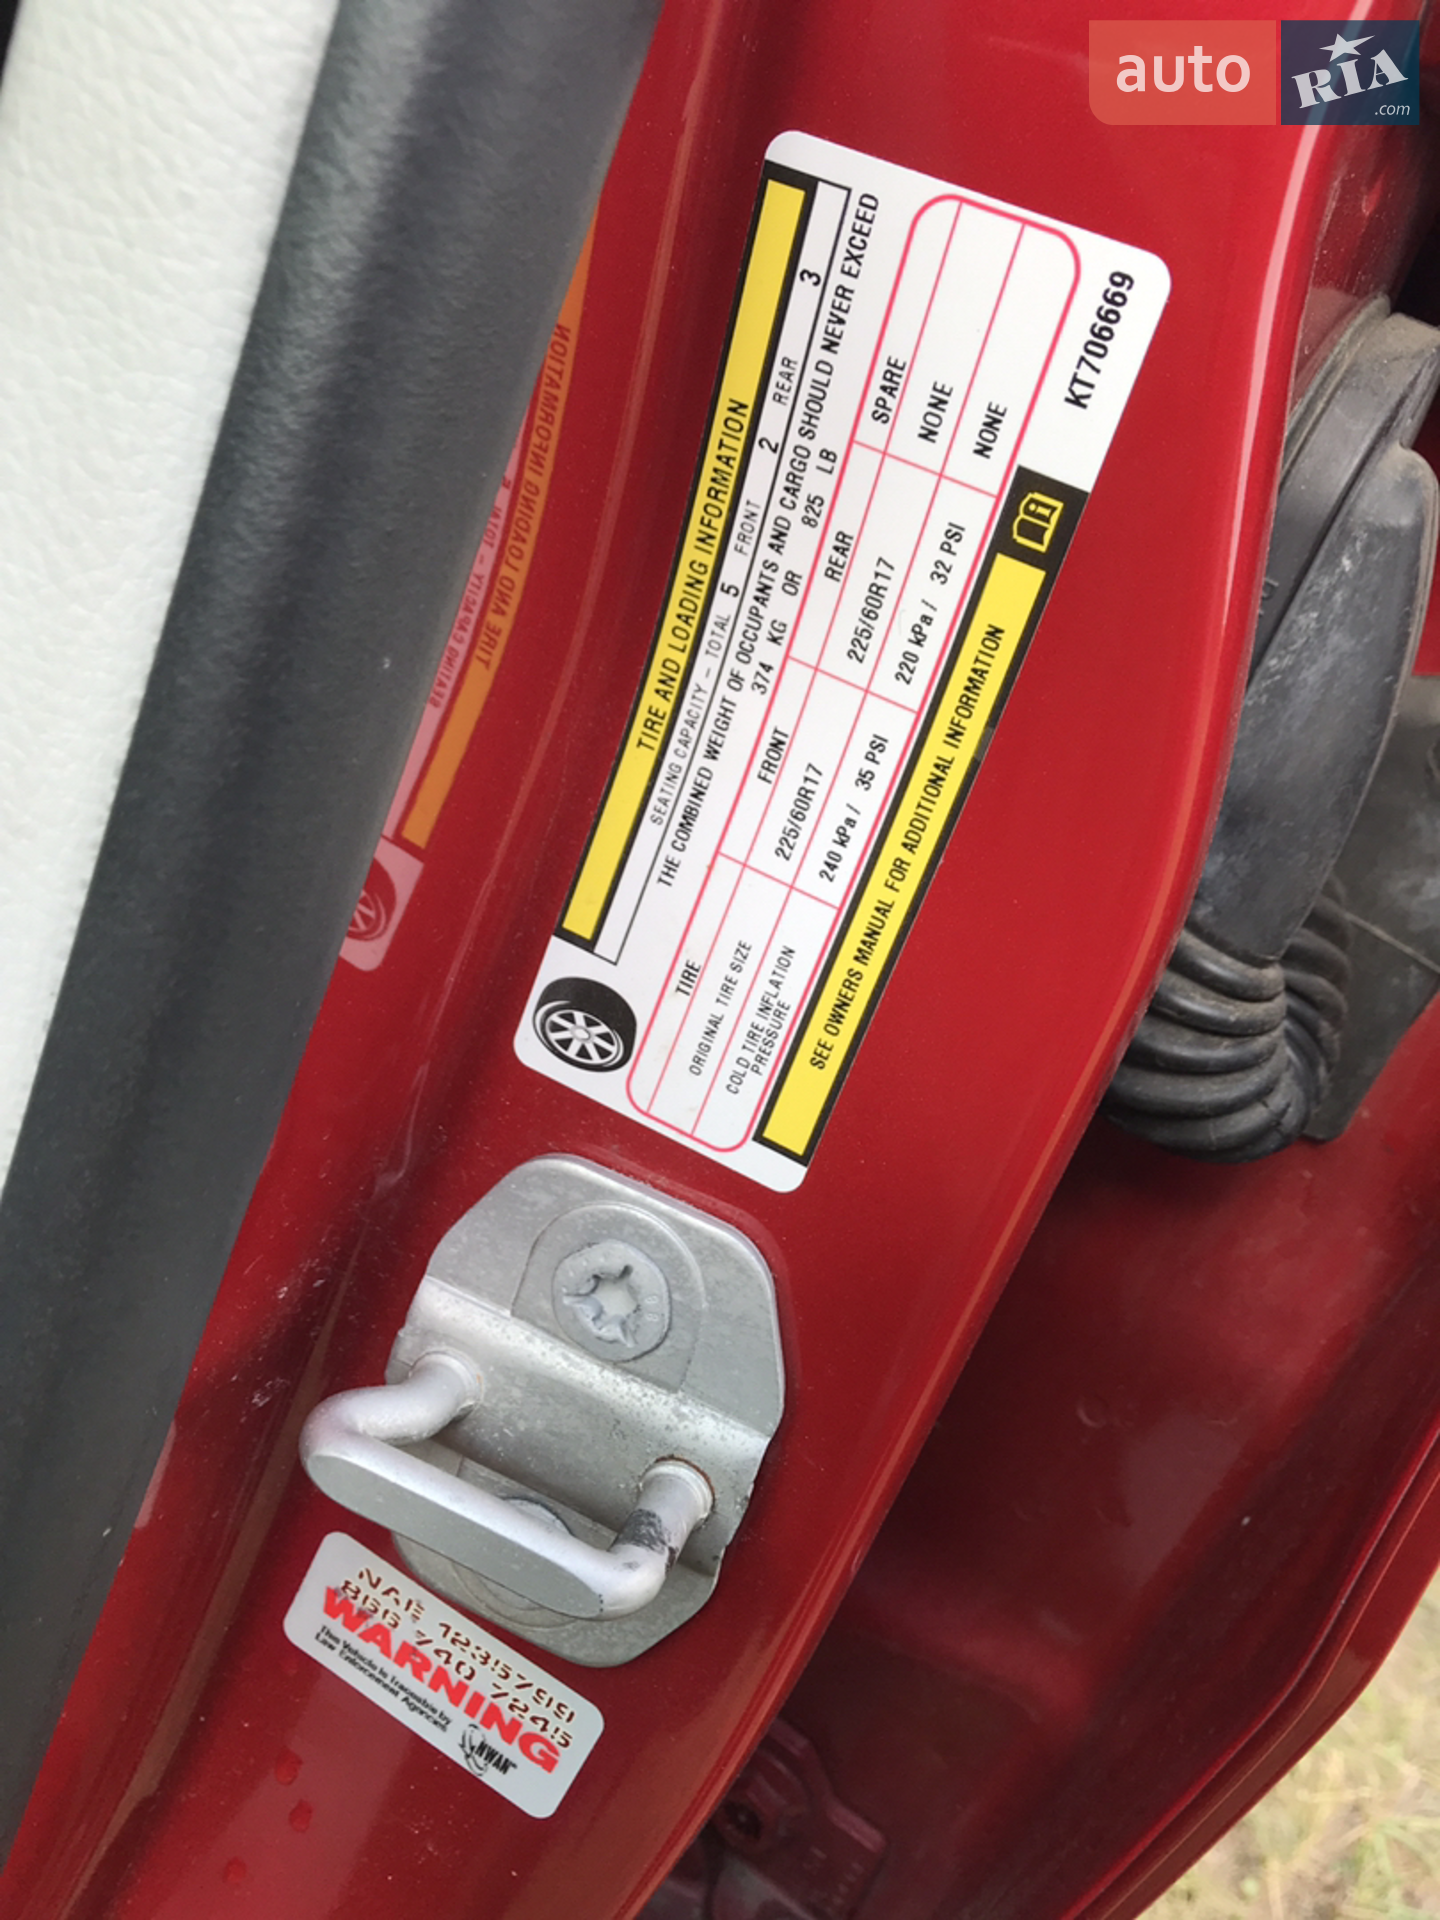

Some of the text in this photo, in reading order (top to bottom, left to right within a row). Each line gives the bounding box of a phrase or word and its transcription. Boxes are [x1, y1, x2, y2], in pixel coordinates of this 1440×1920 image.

[1063, 270, 1135, 411] KT706669
[870, 355, 907, 425] SPARE
[916, 380, 954, 445] NONE
[972, 402, 1008, 460] NONE
[649, 761, 684, 827] SEATING
[672, 682, 708, 760] CAPACITY
[703, 614, 732, 659] TOTAL
[718, 581, 741, 599] 5
[732, 498, 760, 556] FRONT
[757, 436, 781, 455] 2
[771, 355, 798, 406] REAR
[798, 268, 823, 288] 3
[656, 192, 880, 888] THE COMBINED WEIGHT OF OCCUPANTS AND CARGO SHOULD NEVER EXCEED
[750, 447, 839, 696] 374 KG OR 825 LB
[823, 529, 855, 583] REAR
[928, 558, 954, 586] 32
[938, 521, 966, 557] PSI
[635, 397, 750, 752] TIRE AND LOADING INFORMATION
[845, 556, 896, 665] 225/60R17
[906, 613, 935, 649] kPa
[893, 649, 921, 686] 220
[756, 726, 790, 785] FRONT
[853, 767, 877, 792] 35
[863, 733, 889, 766] PSI
[773, 762, 824, 862] 225/60R17
[831, 816, 858, 849] kPa
[808, 623, 1006, 1071] SEE OWNERS MANUAL FOR ADDITIONAL INFORMATION
[817, 849, 843, 884] 240
[674, 960, 702, 997] TIRE
[688, 939, 753, 1077] ORIGINAL TIRE SIZE
[724, 944, 797, 1096] COLD TIRE INFLATION
[749, 999, 791, 1077] PRESSURE
[323, 1586, 560, 1774] WARNING
[337, 1648, 401, 1699] Enforcement
[339, 1579, 573, 1748] 866 740 7245
